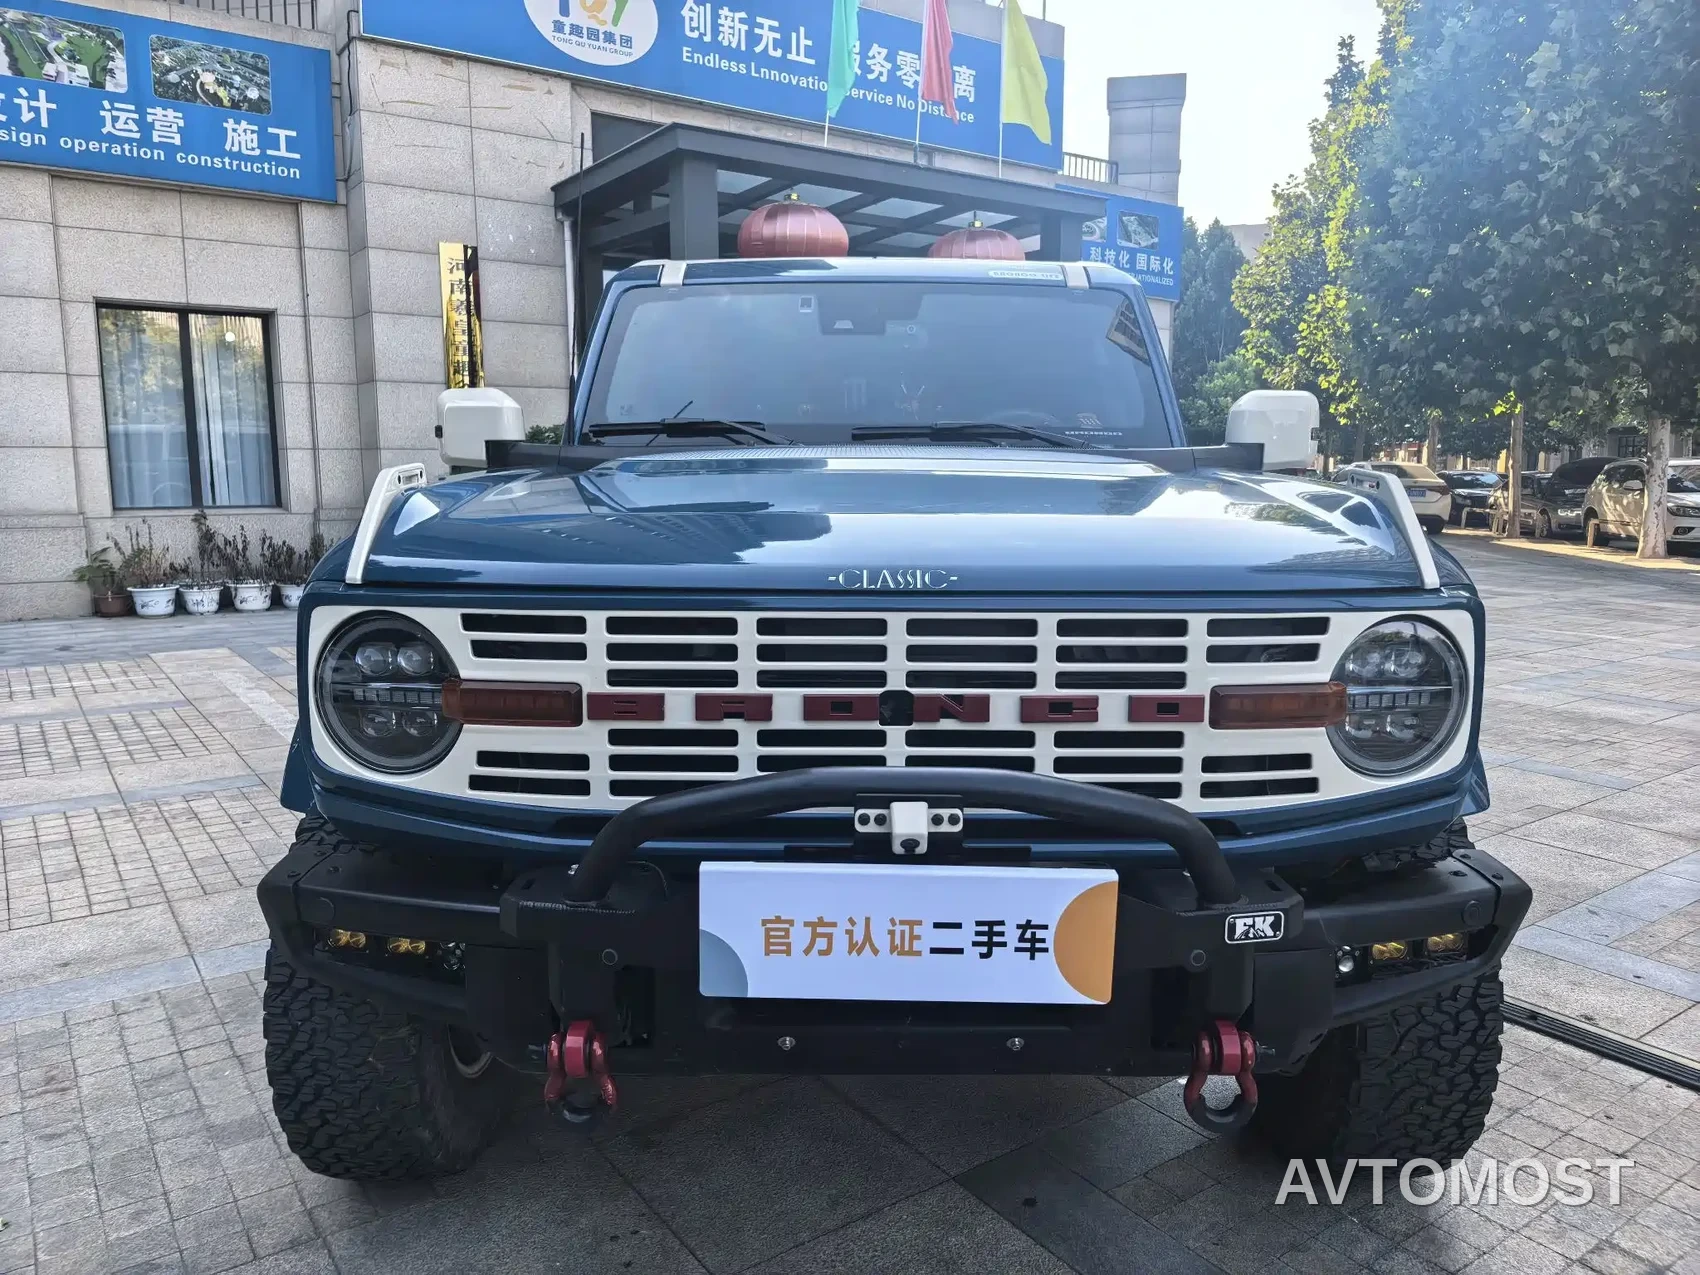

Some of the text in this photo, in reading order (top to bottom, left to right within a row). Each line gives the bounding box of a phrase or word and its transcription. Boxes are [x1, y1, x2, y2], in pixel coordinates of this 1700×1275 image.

[552, 19, 633, 50] 童趣园集团
[552, 35, 574, 45] TONG
[587, 42, 608, 53] YUAN
[608, 48, 633, 58] GROUP
[681, 0, 816, 65] 创新无止
[682, 46, 747, 74] Endless
[751, 61, 828, 92] Lnnovatio
[896, 93, 915, 110] No
[918, 99, 975, 123] Distce
[852, 40, 976, 103] 务零离
[0, 87, 301, 160] 计 运营 施工
[59, 136, 165, 161] operation
[176, 152, 300, 179] construction
[1090, 246, 1174, 276] 科技化 国际化
[760, 915, 1050, 961] 官方认证二手车
